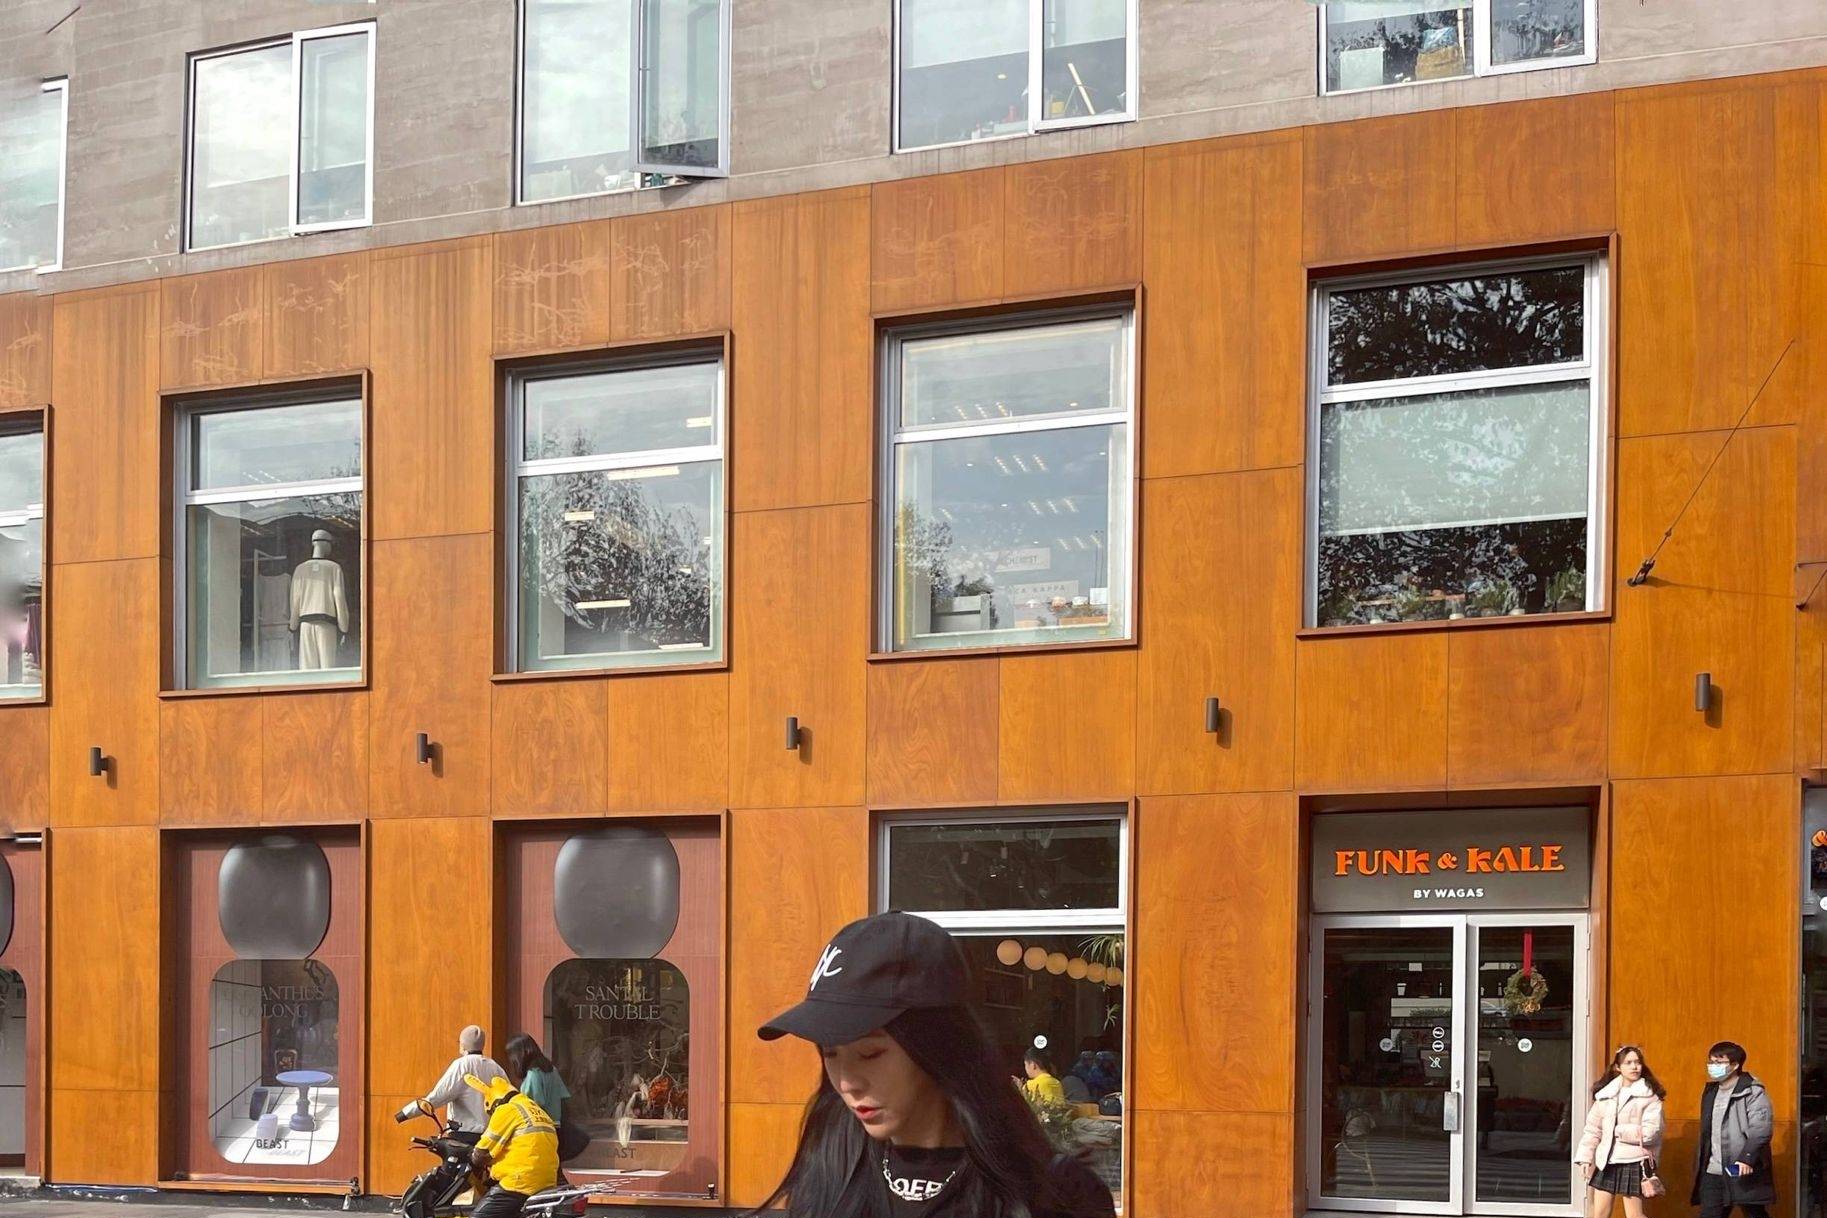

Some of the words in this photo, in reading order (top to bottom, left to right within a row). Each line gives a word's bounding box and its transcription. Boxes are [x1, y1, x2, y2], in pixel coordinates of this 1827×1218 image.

[1335, 849, 1430, 875] FUNK
[1437, 852, 1458, 869] &
[1466, 846, 1565, 873] KALE
[1413, 889, 1431, 898] BY
[1434, 888, 1484, 898] WAGAS
[575, 1004, 661, 1020] TROUBLE
[256, 1139, 289, 1149] BEAST
